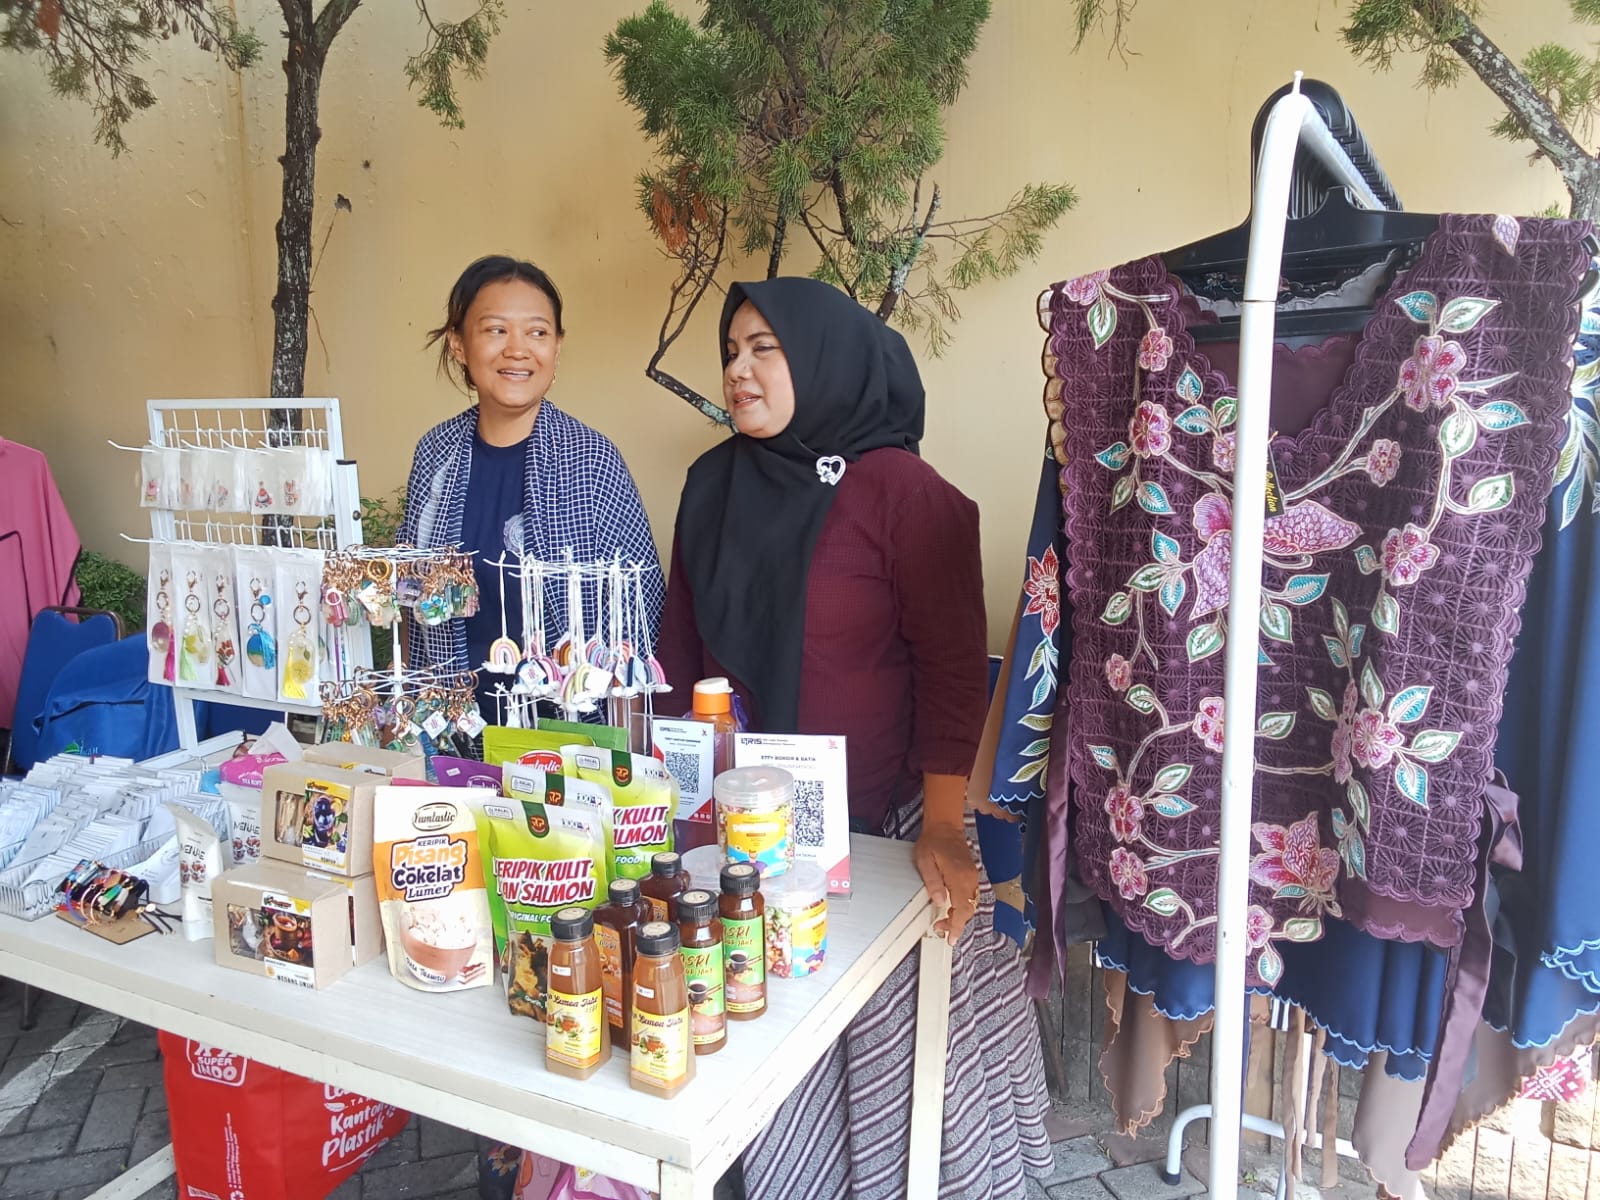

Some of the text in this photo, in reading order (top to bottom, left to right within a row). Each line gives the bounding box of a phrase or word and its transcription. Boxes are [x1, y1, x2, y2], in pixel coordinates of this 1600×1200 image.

[414, 810, 456, 824] Yumtastic
[621, 806, 669, 826] KULIT
[417, 838, 447, 847] KERIPIK
[614, 824, 667, 845] LMON
[394, 844, 464, 868] Pisang
[616, 856, 641, 864] FOOD
[393, 863, 461, 887] Cokelat
[495, 859, 592, 881] ERIPIK KULIT
[407, 885, 450, 899] Lumer
[521, 880, 594, 903] SALMON
[197, 1056, 233, 1066] SUPER
[196, 1063, 238, 1081] INDO
[322, 1111, 385, 1167] Plastik
